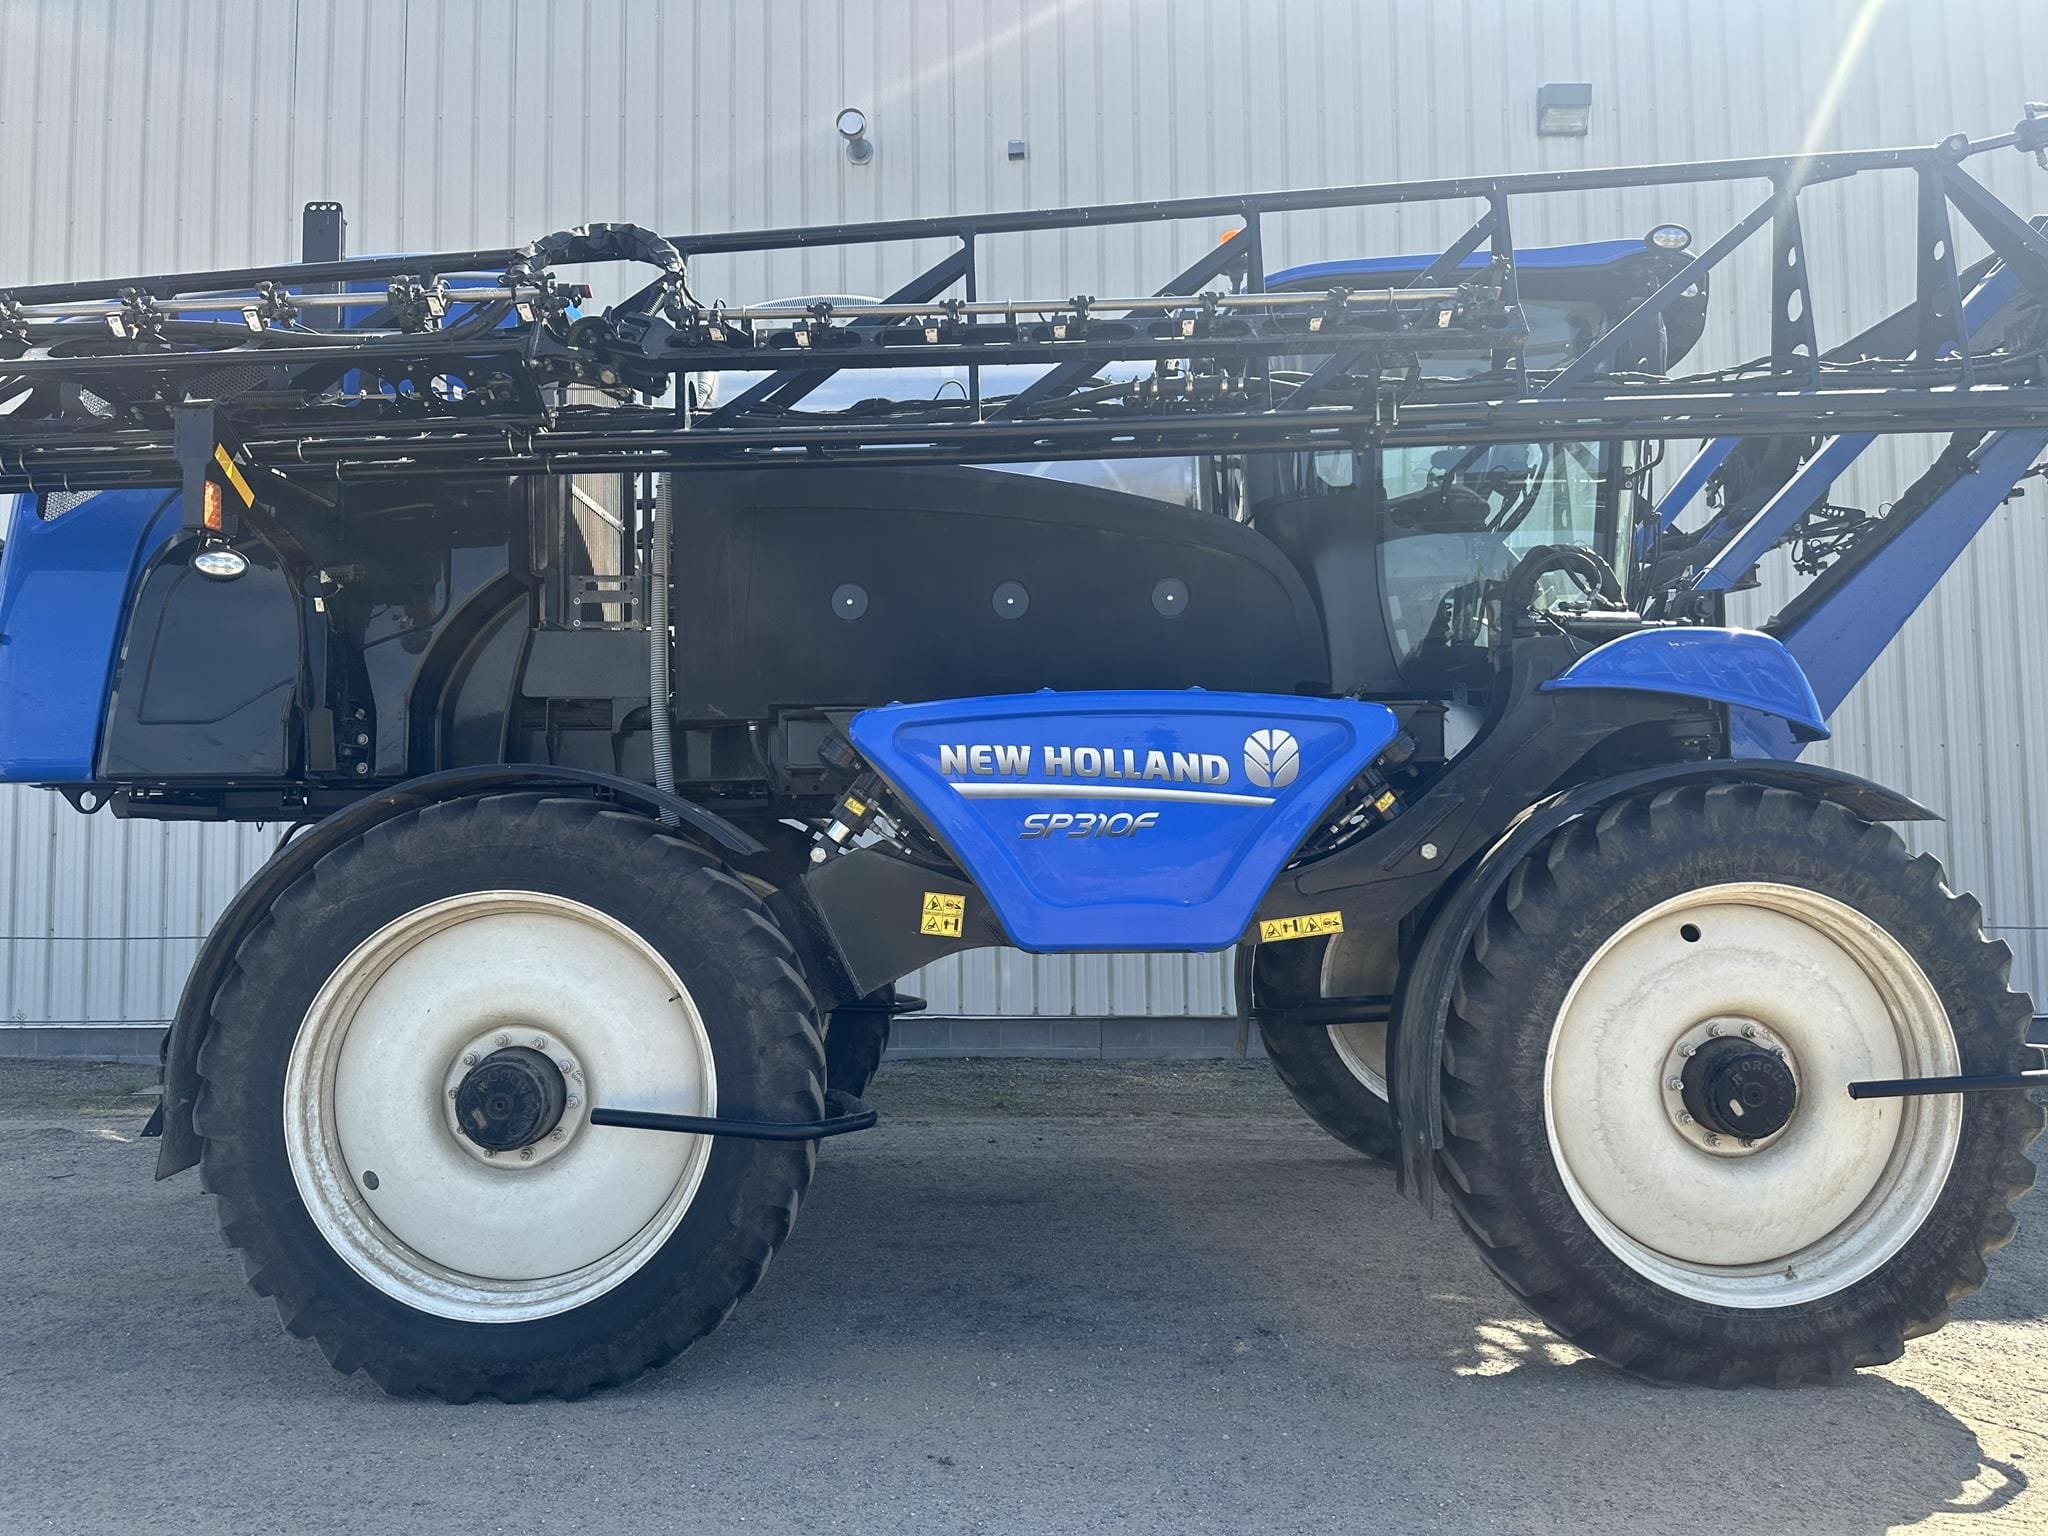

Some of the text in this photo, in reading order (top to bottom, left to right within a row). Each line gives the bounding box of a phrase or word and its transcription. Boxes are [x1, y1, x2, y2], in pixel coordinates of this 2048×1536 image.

[939, 744, 1230, 785] NEW HOLLAND
[1018, 812, 1160, 840] SP310F
